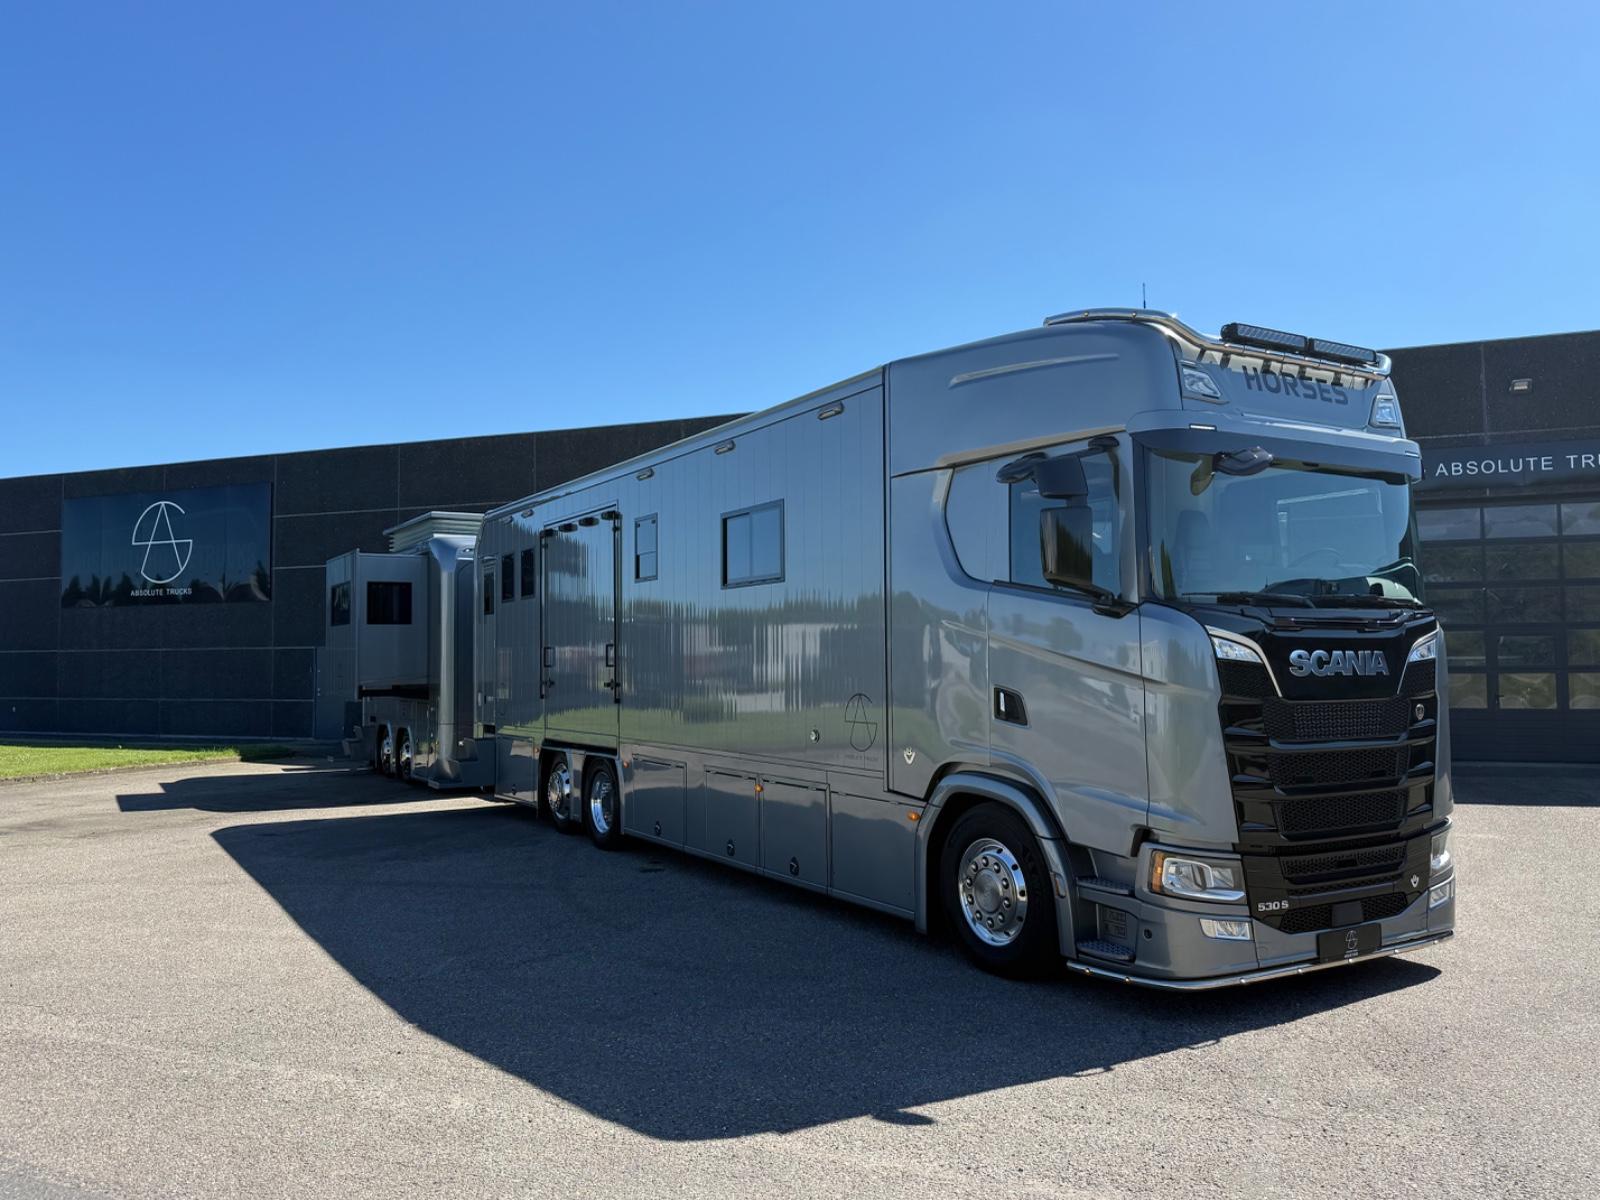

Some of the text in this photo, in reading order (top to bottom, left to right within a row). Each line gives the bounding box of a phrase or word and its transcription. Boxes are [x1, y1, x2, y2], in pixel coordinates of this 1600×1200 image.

[1242, 365, 1349, 406] HORSES
[1435, 453, 1600, 477] ABSOLUTE TR
[130, 587, 193, 597] ABSOLUTE TRUCKS
[1289, 649, 1390, 677] SCANIA
[1257, 901, 1280, 912] 530
